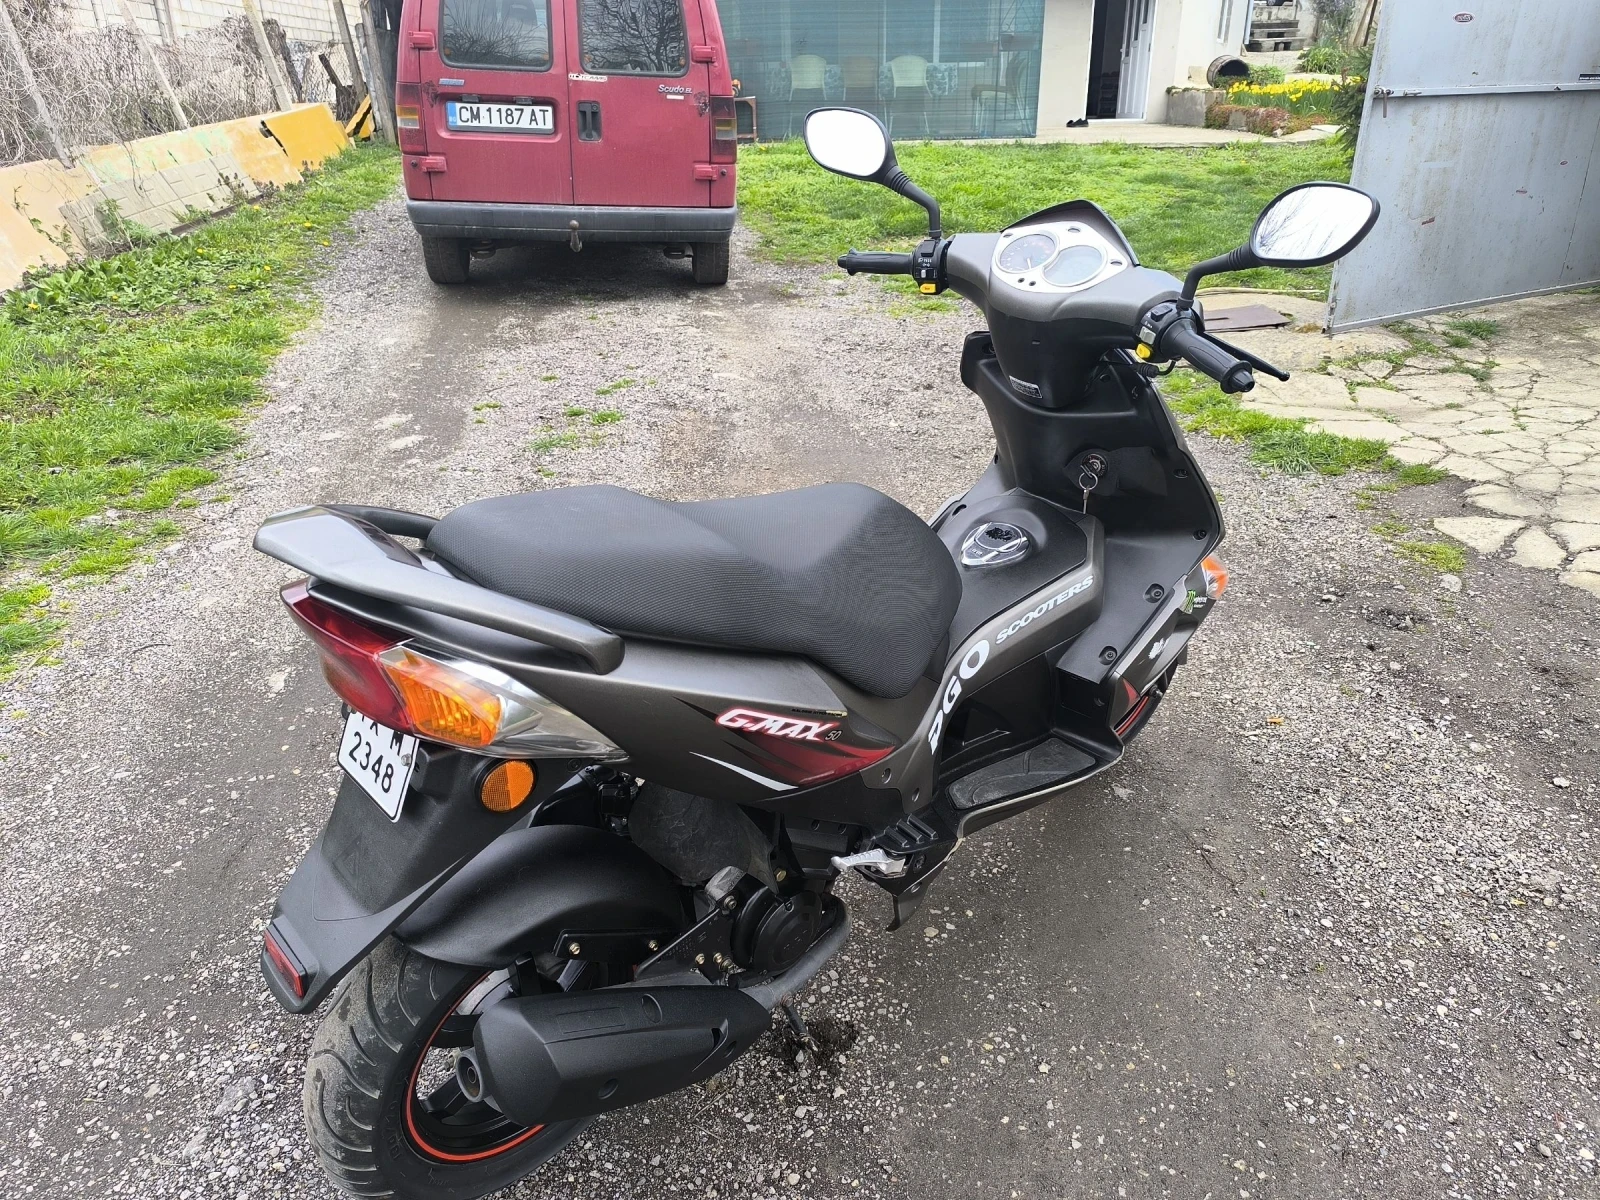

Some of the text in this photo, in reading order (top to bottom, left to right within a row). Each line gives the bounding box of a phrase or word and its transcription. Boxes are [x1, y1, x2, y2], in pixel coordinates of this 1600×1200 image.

[658, 84, 685, 93] Scudo
[459, 106, 480, 124] CM
[486, 107, 525, 125] 1187
[529, 108, 549, 126] AT
[928, 575, 1094, 756] PGO SCOOTERS
[389, 730, 405, 757] M
[824, 730, 842, 741] 50
[348, 731, 394, 794] 2348
